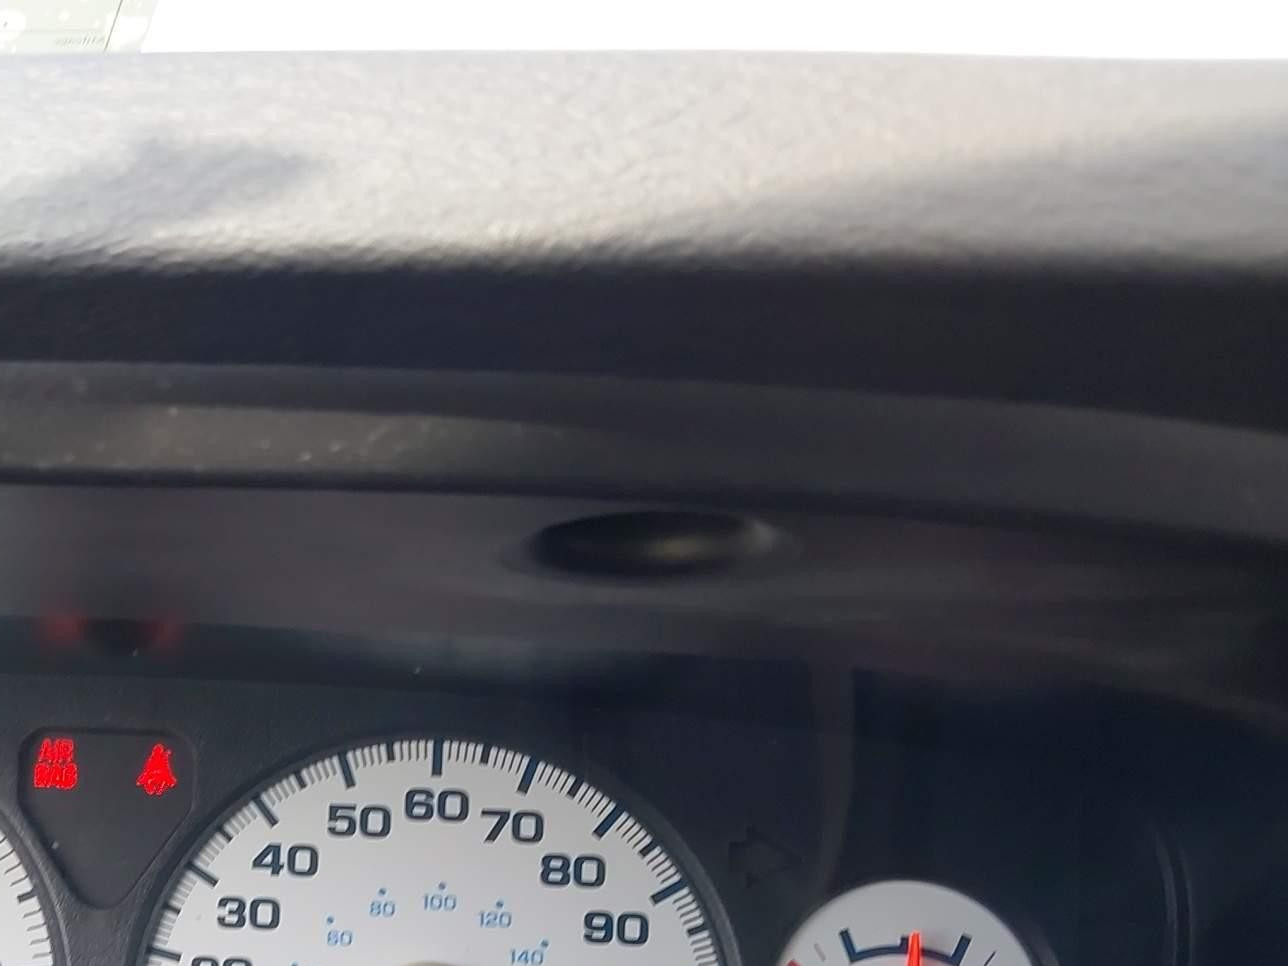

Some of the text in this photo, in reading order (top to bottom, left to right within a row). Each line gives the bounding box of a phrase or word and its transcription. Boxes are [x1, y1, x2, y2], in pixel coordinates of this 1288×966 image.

[39, 738, 74, 763] AIR
[327, 804, 392, 838] 50
[404, 788, 470, 822] 60
[481, 809, 544, 844] 70
[252, 843, 319, 877] 40
[540, 854, 606, 888] 80
[217, 896, 281, 930] 30
[369, 901, 396, 917] 80
[424, 894, 457, 911] 100
[478, 910, 513, 929] 120
[583, 911, 649, 945] 90
[509, 948, 546, 966] 140
